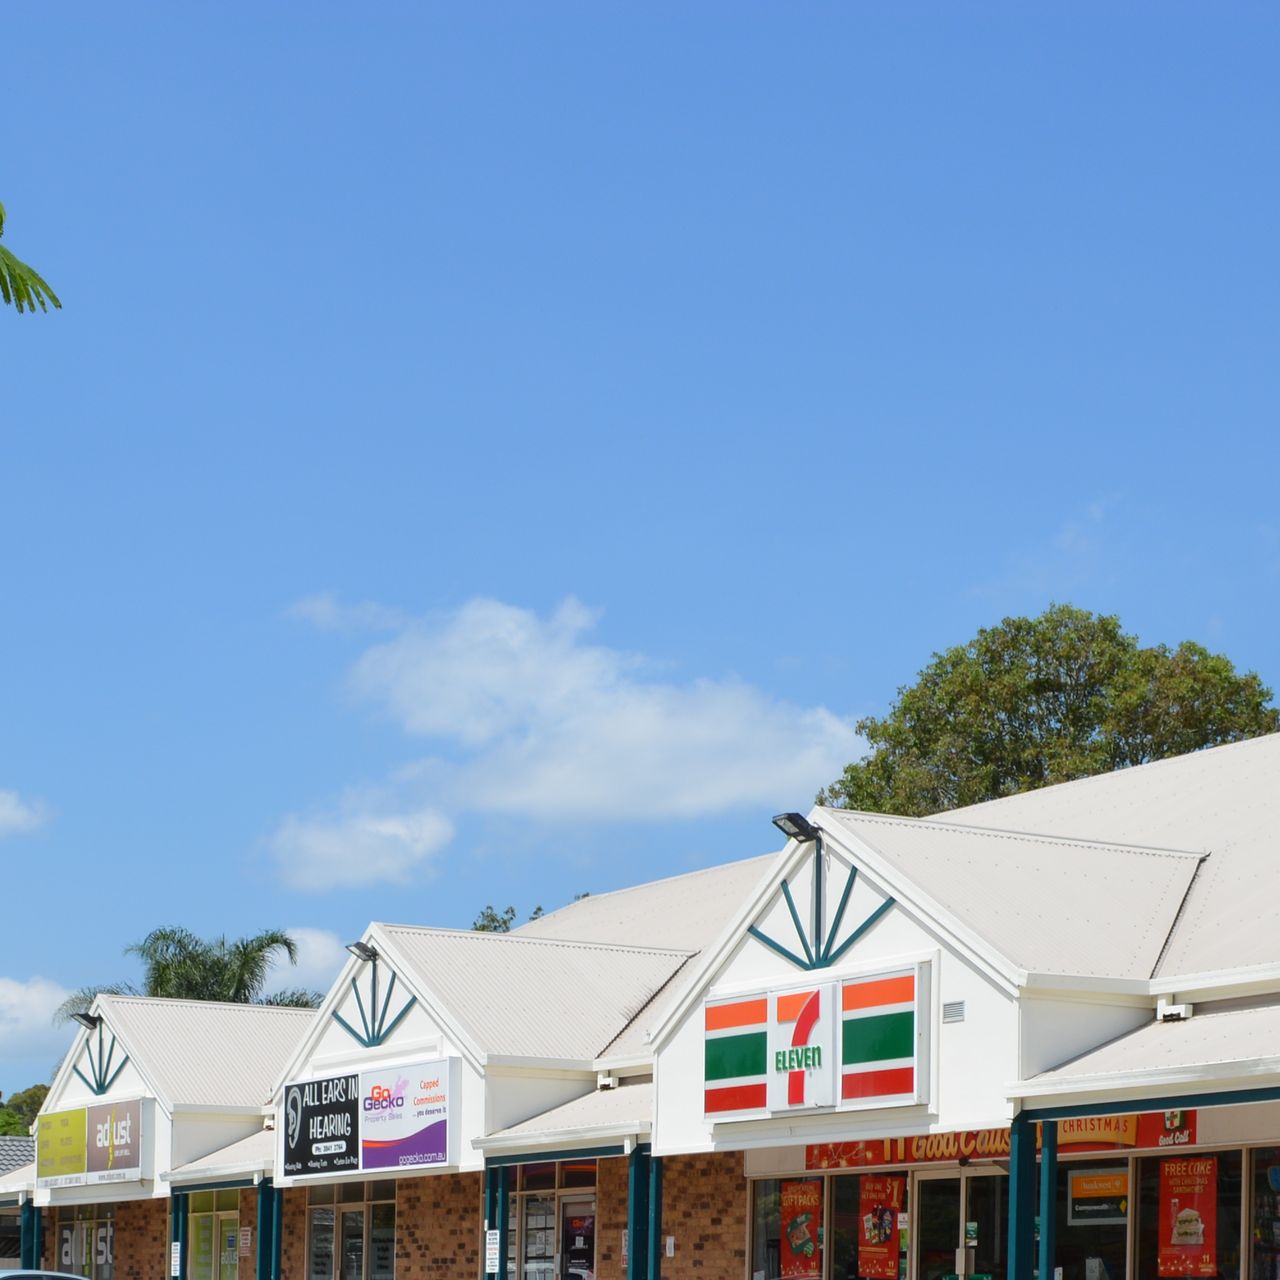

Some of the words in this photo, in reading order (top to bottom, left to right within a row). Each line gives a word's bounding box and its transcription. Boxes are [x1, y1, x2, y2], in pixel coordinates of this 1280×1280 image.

[777, 990, 820, 1105] 7
[303, 1083, 320, 1107] ALL
[322, 1078, 346, 1105] EARS
[348, 1076, 358, 1101] IN
[420, 1078, 439, 1090] Capped
[372, 1085, 390, 1101] Go
[363, 1094, 404, 1111] Gecko
[309, 1112, 351, 1140] HEARING
[1062, 1118, 1128, 1134] CHRISTMAS
[911, 1131, 958, 1160] Good
[1158, 1133, 1174, 1146] Good
[1164, 1162, 1188, 1177] FREE
